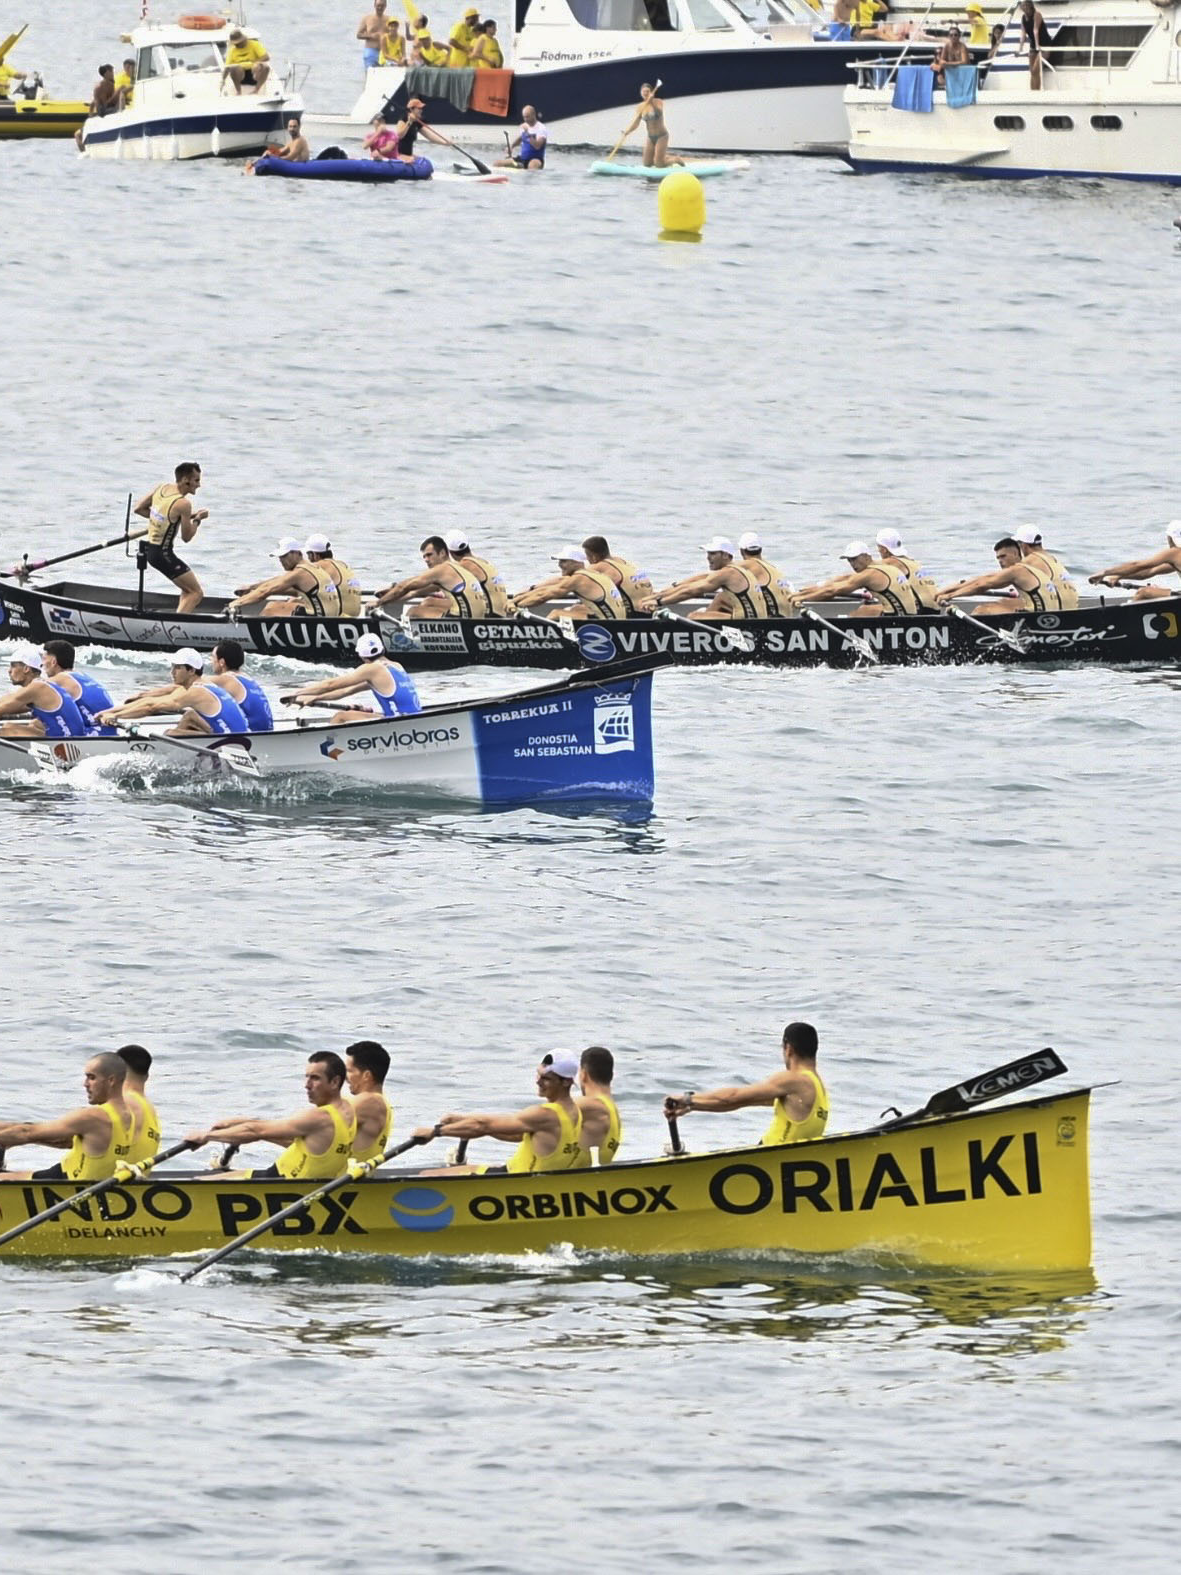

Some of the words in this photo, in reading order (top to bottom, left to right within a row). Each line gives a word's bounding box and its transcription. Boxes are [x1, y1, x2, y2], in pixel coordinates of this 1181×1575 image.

[540, 50, 584, 61] Rodman
[418, 623, 459, 634] ELKANO
[473, 624, 560, 640] GETARIA
[767, 629, 829, 652] SAN
[482, 703, 560, 725] TORREKUA
[528, 734, 578, 746] DONOSTIA
[513, 748, 536, 758] SAN
[537, 745, 593, 757] SEBASTIAN
[955, 1056, 1057, 1102] KEMEN
[708, 1131, 1043, 1215] ORIALKI
[22, 1183, 193, 1222] INDO
[468, 1184, 679, 1222] ORBINOX
[215, 1191, 370, 1238] PBX
[68, 1226, 167, 1239] DELANCHY
